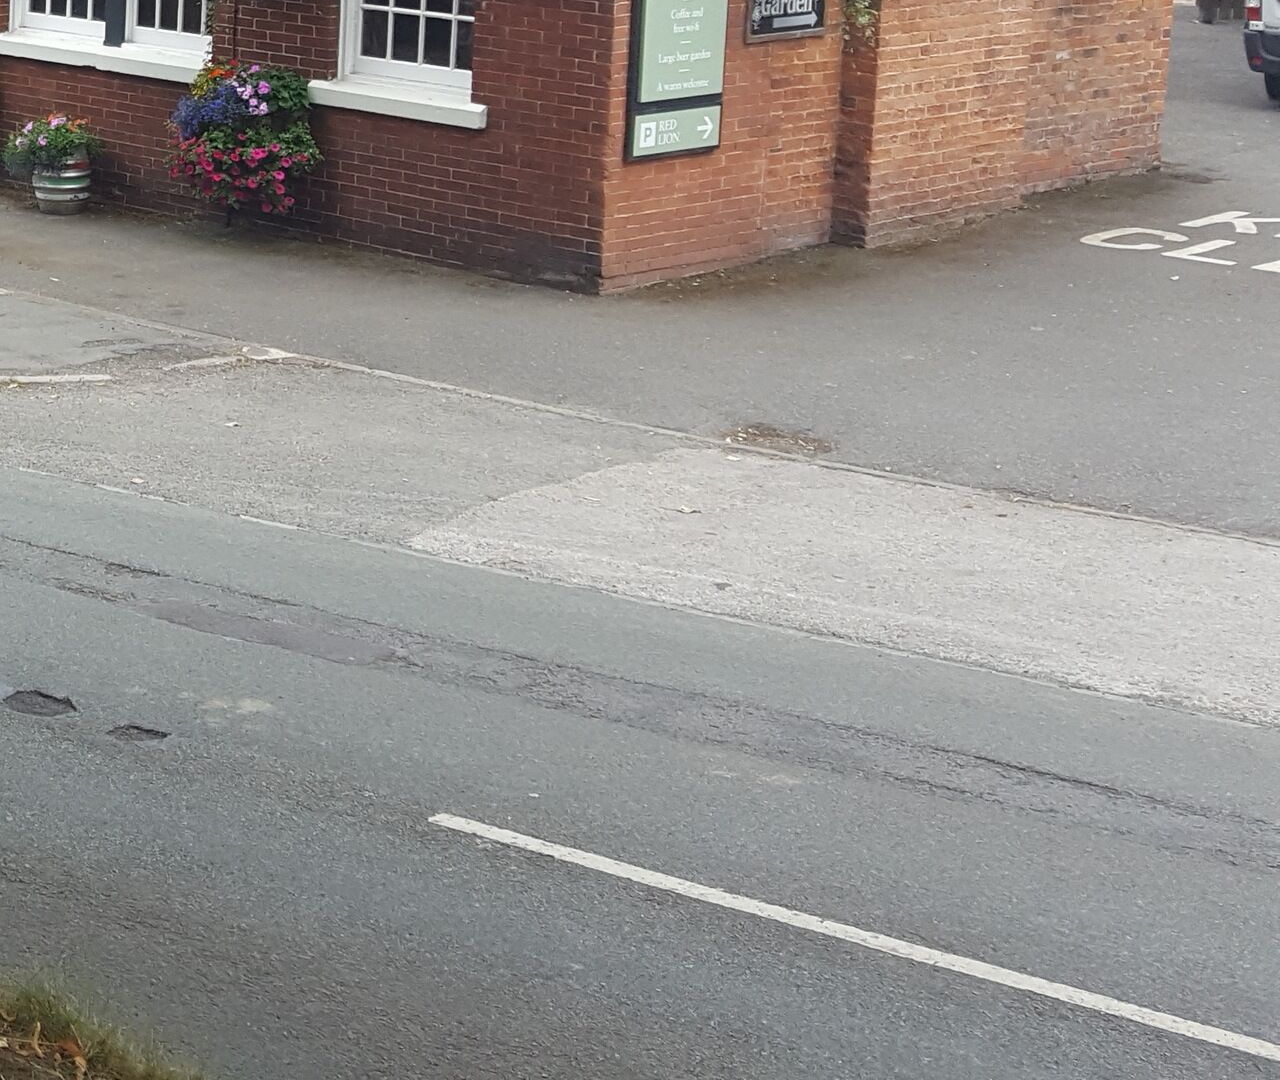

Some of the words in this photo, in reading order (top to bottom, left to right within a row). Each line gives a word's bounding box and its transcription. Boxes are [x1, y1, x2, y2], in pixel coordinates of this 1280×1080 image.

[658, 119, 678, 132] RED
[644, 127, 653, 143] P
[658, 132, 680, 146] LION
